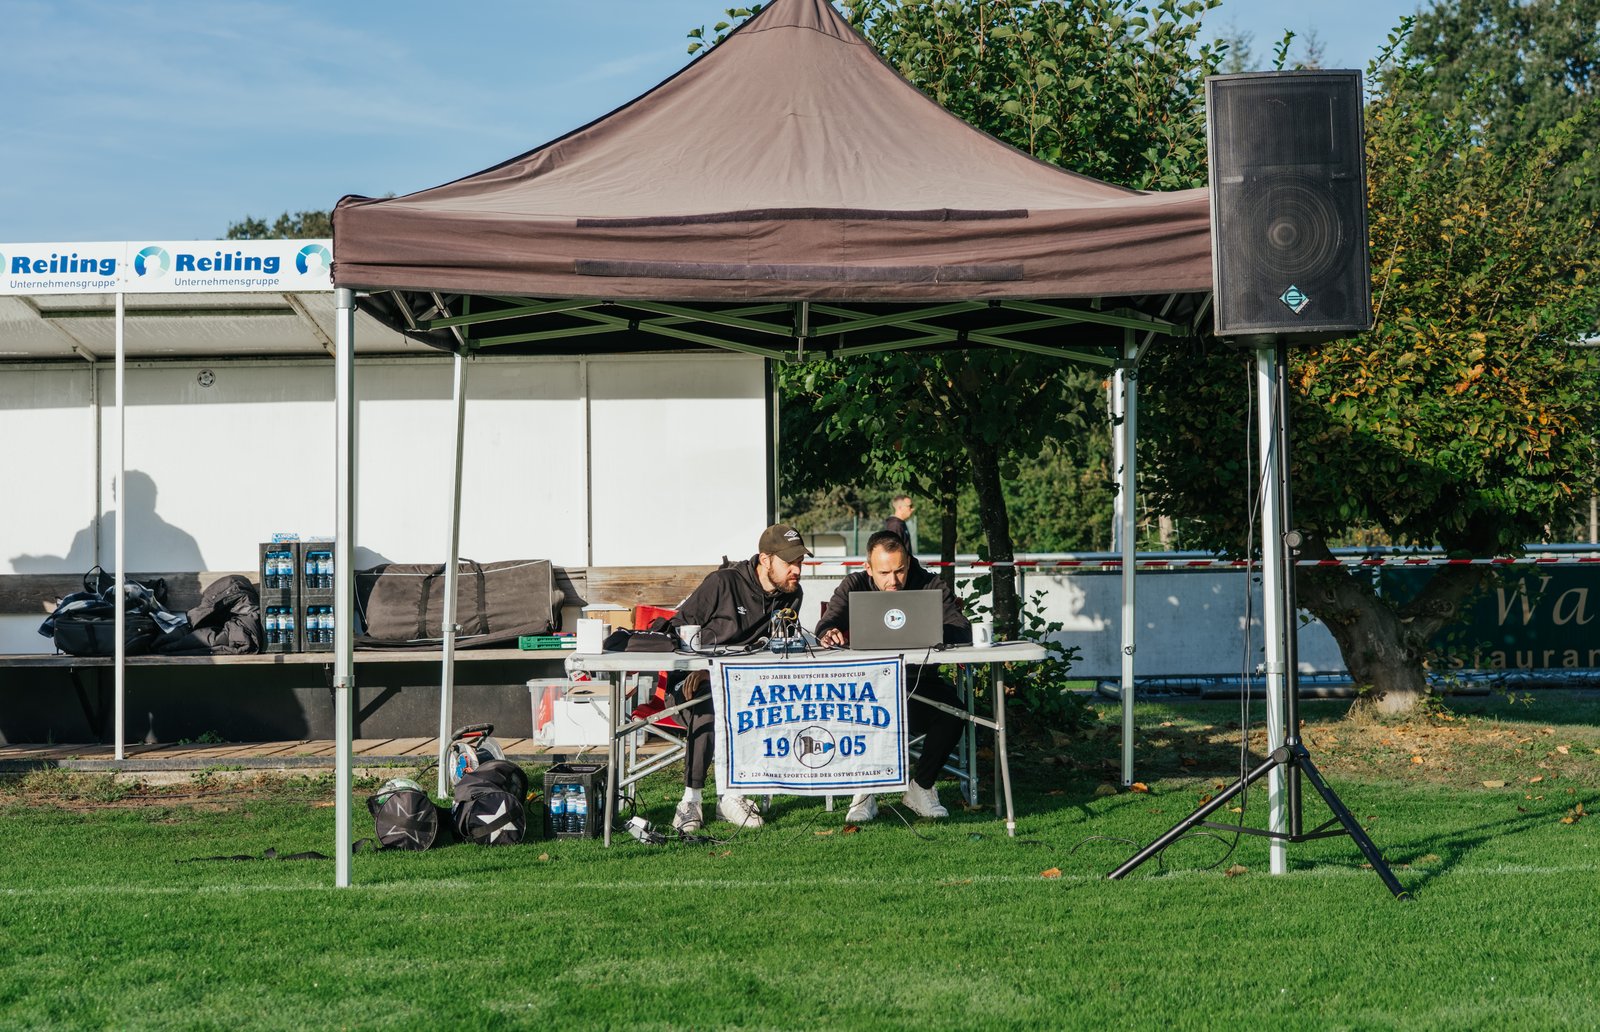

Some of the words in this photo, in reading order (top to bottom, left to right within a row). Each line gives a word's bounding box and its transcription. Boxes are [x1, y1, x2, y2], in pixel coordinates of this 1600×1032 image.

[11, 253, 117, 276] Reiling
[175, 251, 281, 275] Reiling
[10, 279, 116, 289] Unternehmensgruppe
[174, 277, 280, 287] Unternehmensgruppe
[748, 682, 878, 707] ARMINIA
[737, 703, 891, 735] BIELEFELD
[763, 737, 790, 758] 19
[839, 735, 867, 758] 05
